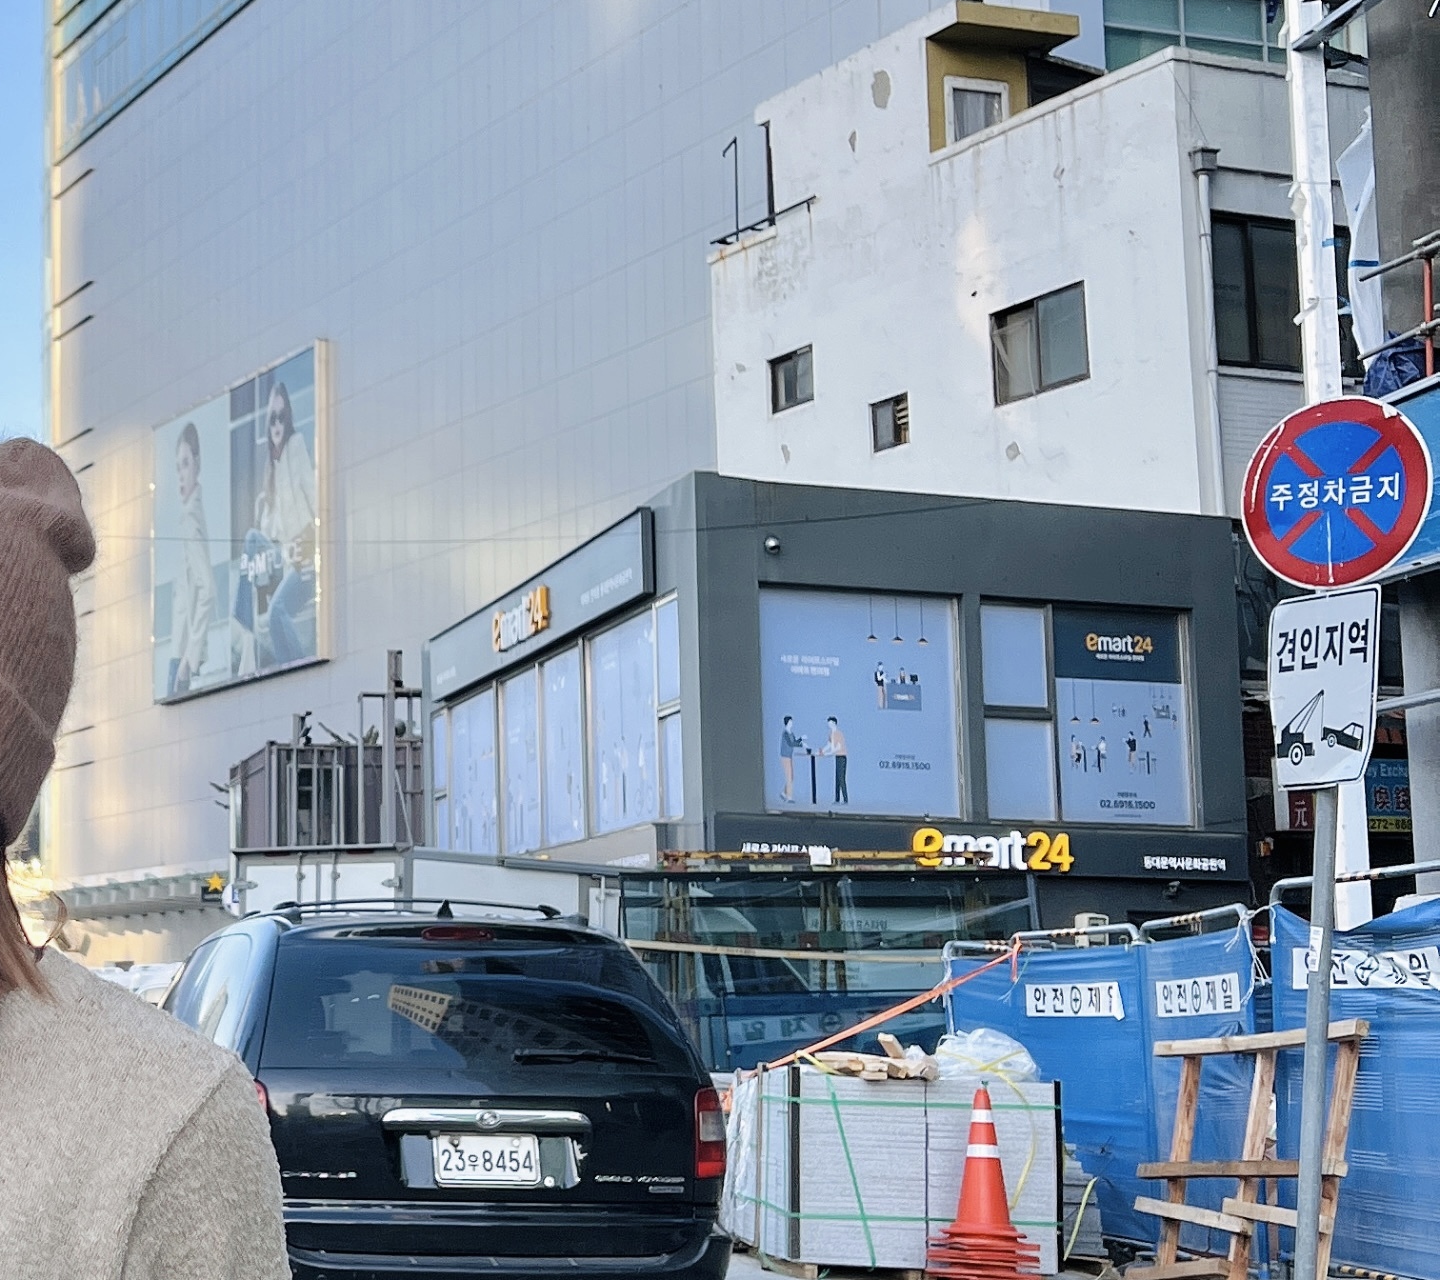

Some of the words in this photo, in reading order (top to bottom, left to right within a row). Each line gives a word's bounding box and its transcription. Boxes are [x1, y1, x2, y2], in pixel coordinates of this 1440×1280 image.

[1270, 472, 1400, 511] 주정차금지
[1085, 633, 1153, 653] emart24
[1277, 619, 1369, 673] 견인지역
[912, 827, 1075, 872] emart24
[1033, 987, 1064, 1013] 안전
[1162, 984, 1187, 1014] 안전
[1206, 978, 1233, 1010] 제일
[441, 1149, 533, 1172] 23우8454
